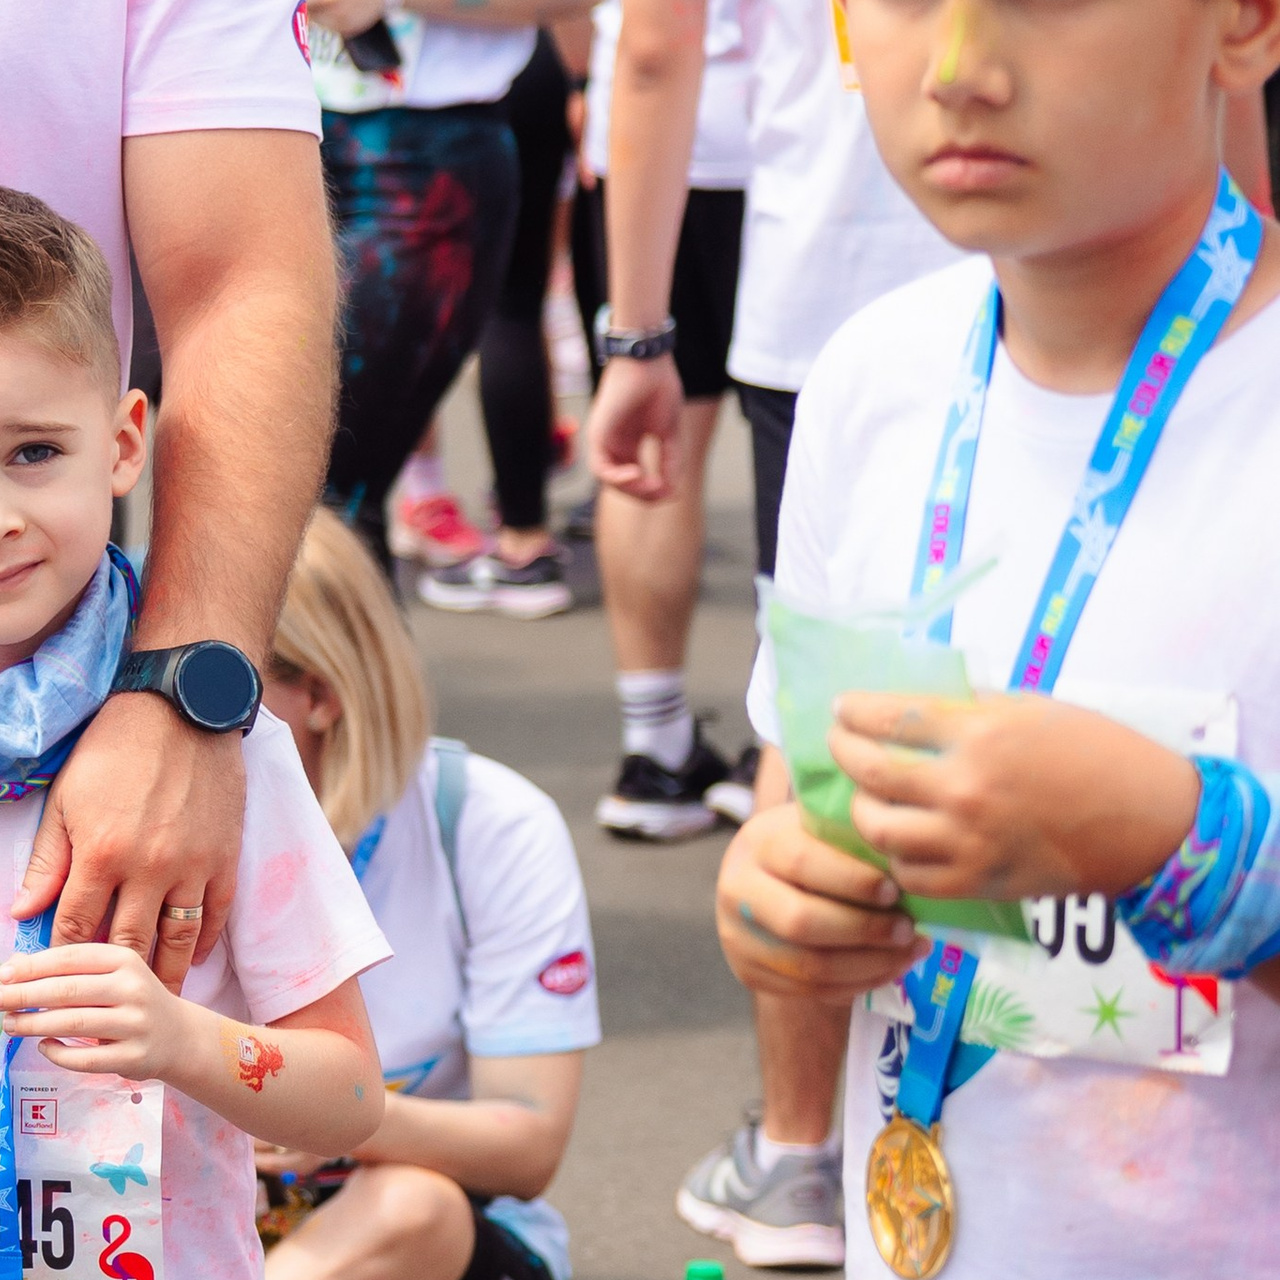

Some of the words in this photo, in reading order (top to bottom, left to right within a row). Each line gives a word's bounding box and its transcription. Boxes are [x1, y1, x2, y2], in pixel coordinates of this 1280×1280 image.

[1128, 351, 1178, 417] COLOR
[1112, 410, 1148, 451] THE
[927, 502, 951, 566] COLOR
